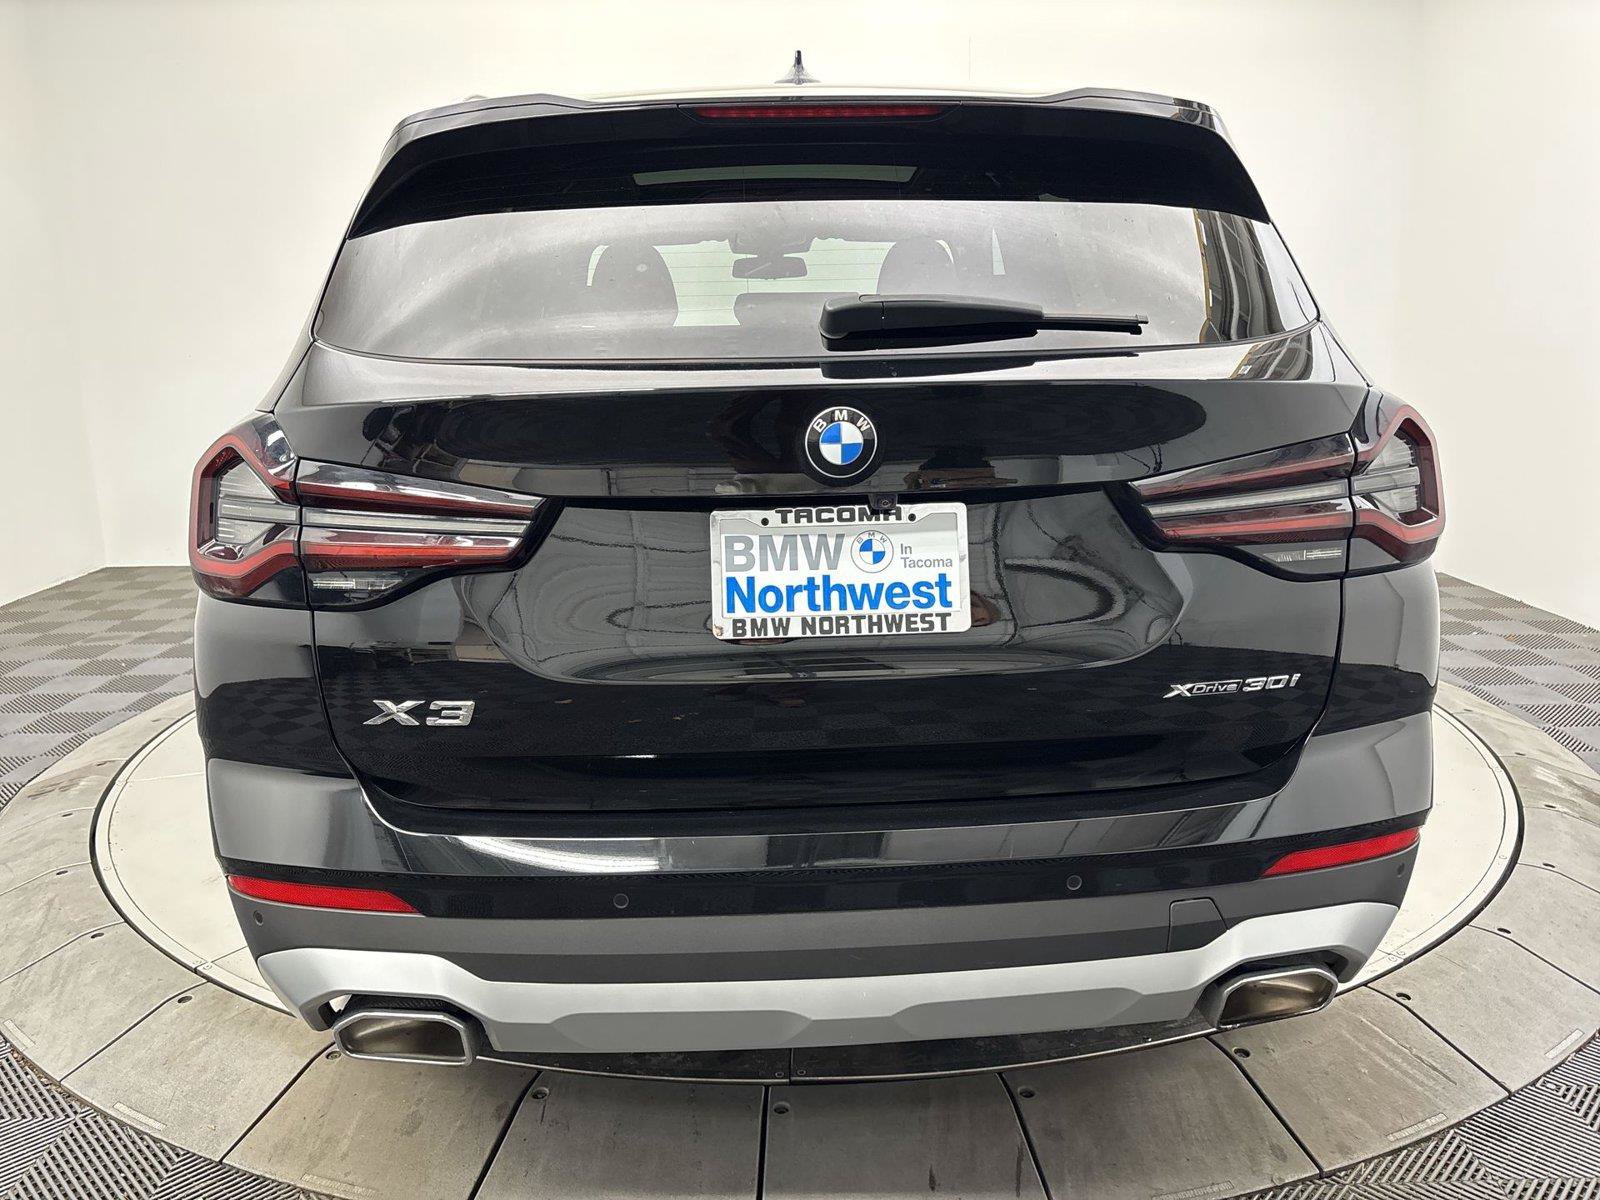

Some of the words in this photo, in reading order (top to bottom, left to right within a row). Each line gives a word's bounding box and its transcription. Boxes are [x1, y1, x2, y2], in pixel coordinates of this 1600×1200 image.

[812, 409, 871, 433] BMW
[856, 531, 887, 545] BMW
[900, 543, 913, 555] In
[724, 533, 845, 572] BMW
[900, 556, 953, 569] Tacoma
[725, 573, 952, 613] Northwest
[732, 618, 791, 638] BMW
[801, 613, 952, 635] NORTHWEST
[362, 699, 475, 726] X3
